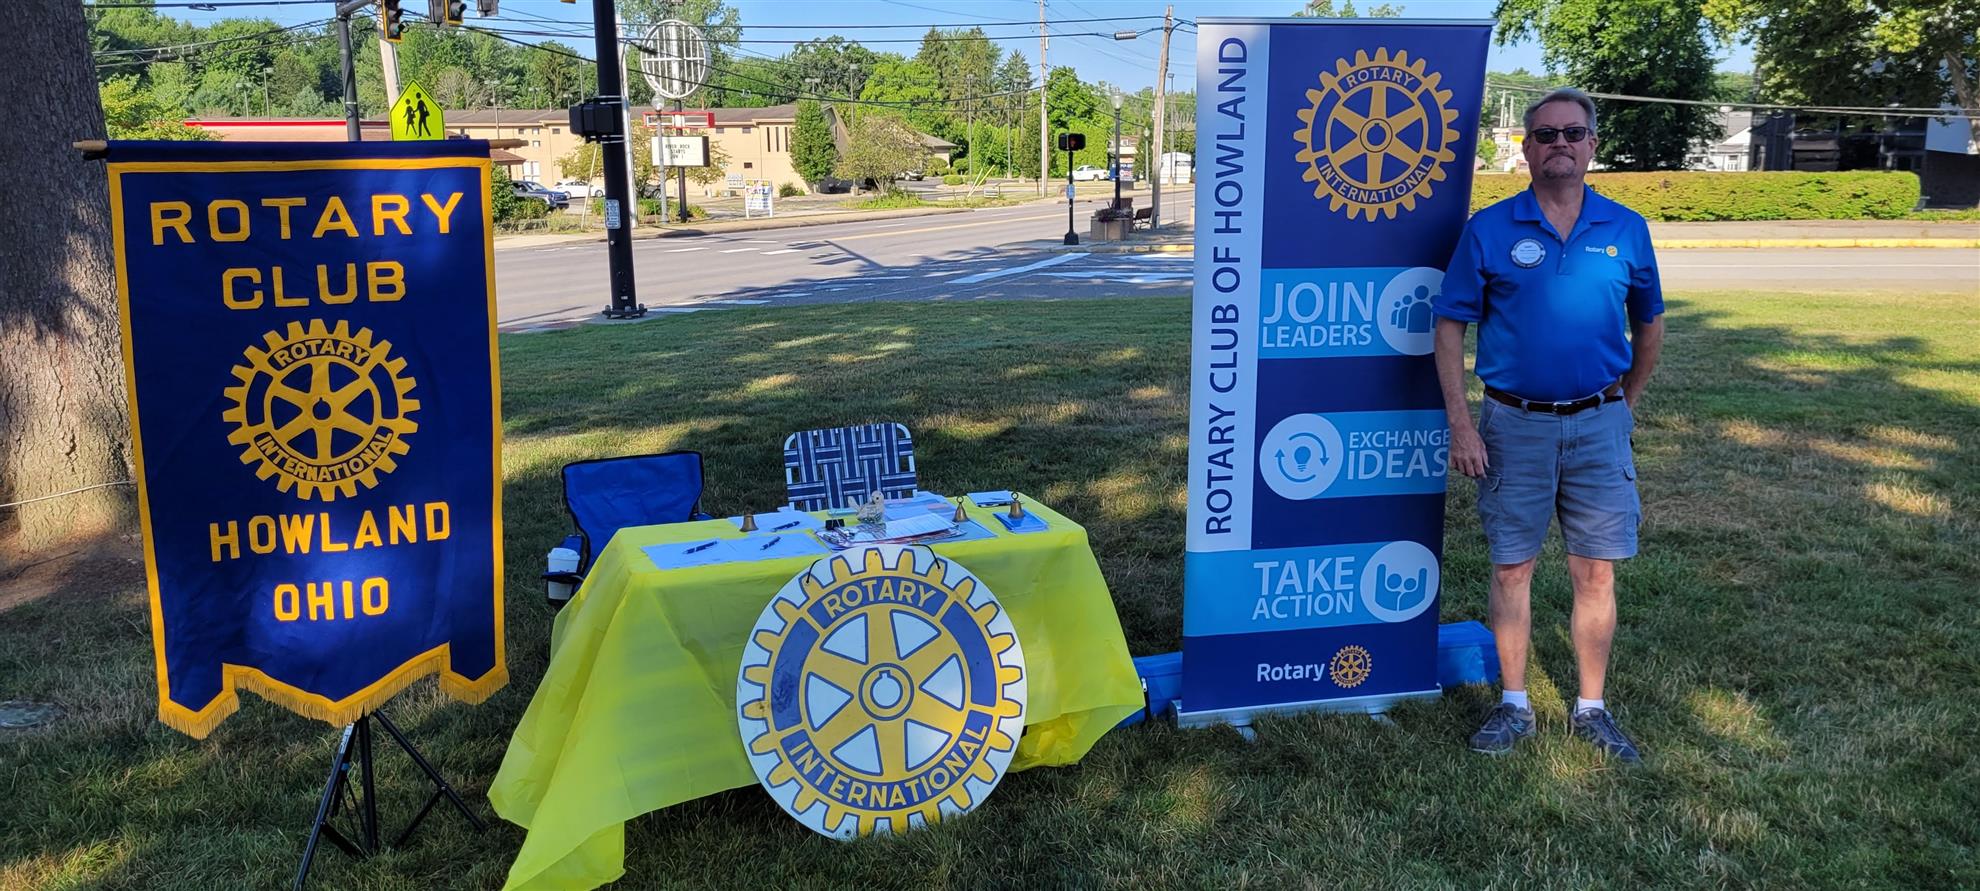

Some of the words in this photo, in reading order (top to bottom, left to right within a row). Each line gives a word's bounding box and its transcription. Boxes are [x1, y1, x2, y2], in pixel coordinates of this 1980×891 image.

[1346, 67, 1415, 88] ROTARY
[1213, 37, 1248, 234] HOWLAND
[1319, 161, 1433, 204] INTERNATIONAL
[150, 192, 463, 246] ROTARY
[1212, 246, 1241, 294] OF
[1585, 246, 1605, 254] Rotary
[222, 261, 406, 310] CLUB
[1263, 281, 1375, 325] JOIN
[273, 339, 369, 368] ROTARY
[1209, 303, 1239, 393] CLUB
[1262, 323, 1373, 348] LEADERS
[254, 430, 393, 482] INTERNATIONAL
[1349, 428, 1451, 449] EXCHANGE
[1205, 403, 1236, 535] ROTARY
[1347, 447, 1449, 481] IDEAS
[209, 501, 450, 562] HOWLAND
[1253, 555, 1356, 597] TAKE
[274, 576, 389, 622] OHIO
[821, 578, 936, 620] ROTARY
[1251, 590, 1355, 621] ACTION
[1256, 662, 1326, 683] Rotary
[789, 724, 988, 809] INTERNATIONAL
